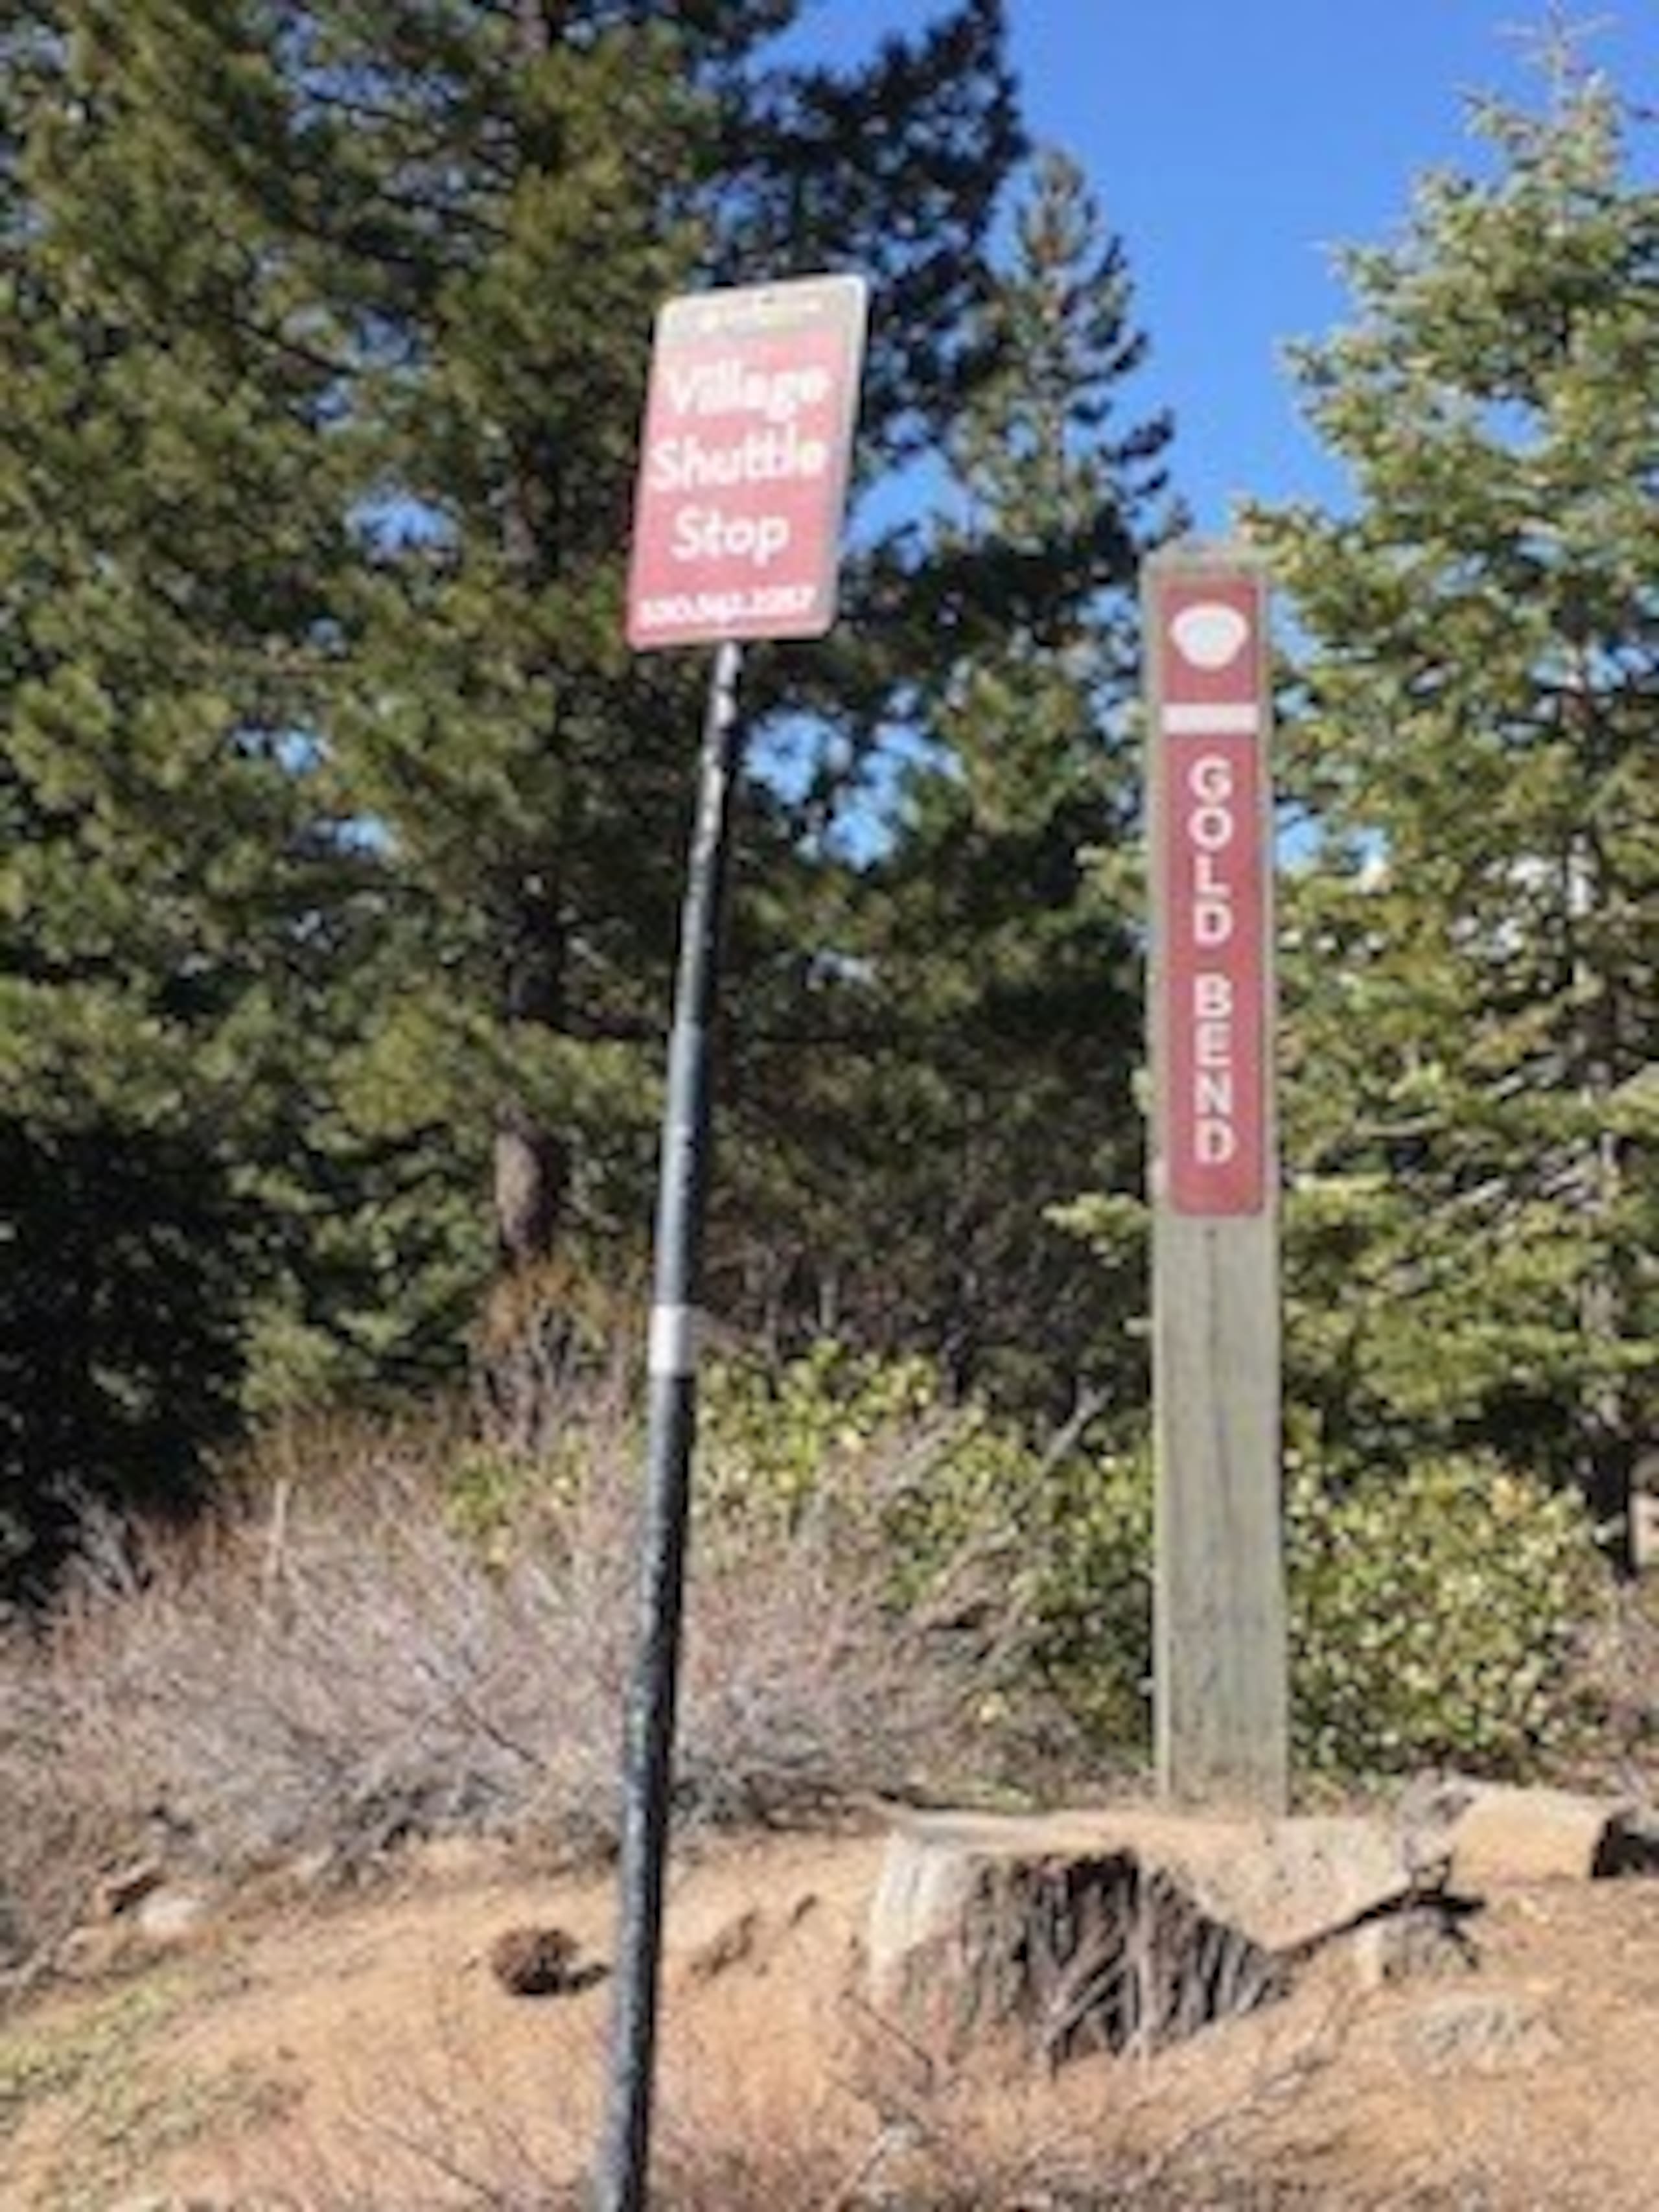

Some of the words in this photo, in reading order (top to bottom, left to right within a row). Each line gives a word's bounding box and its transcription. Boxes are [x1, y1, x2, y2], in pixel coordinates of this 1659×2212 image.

[666, 359, 830, 423] Village
[650, 424, 828, 493] Shuttle
[671, 505, 791, 567] Stop
[1187, 754, 1233, 947] GOLD
[1194, 973, 1236, 1165] BEND
